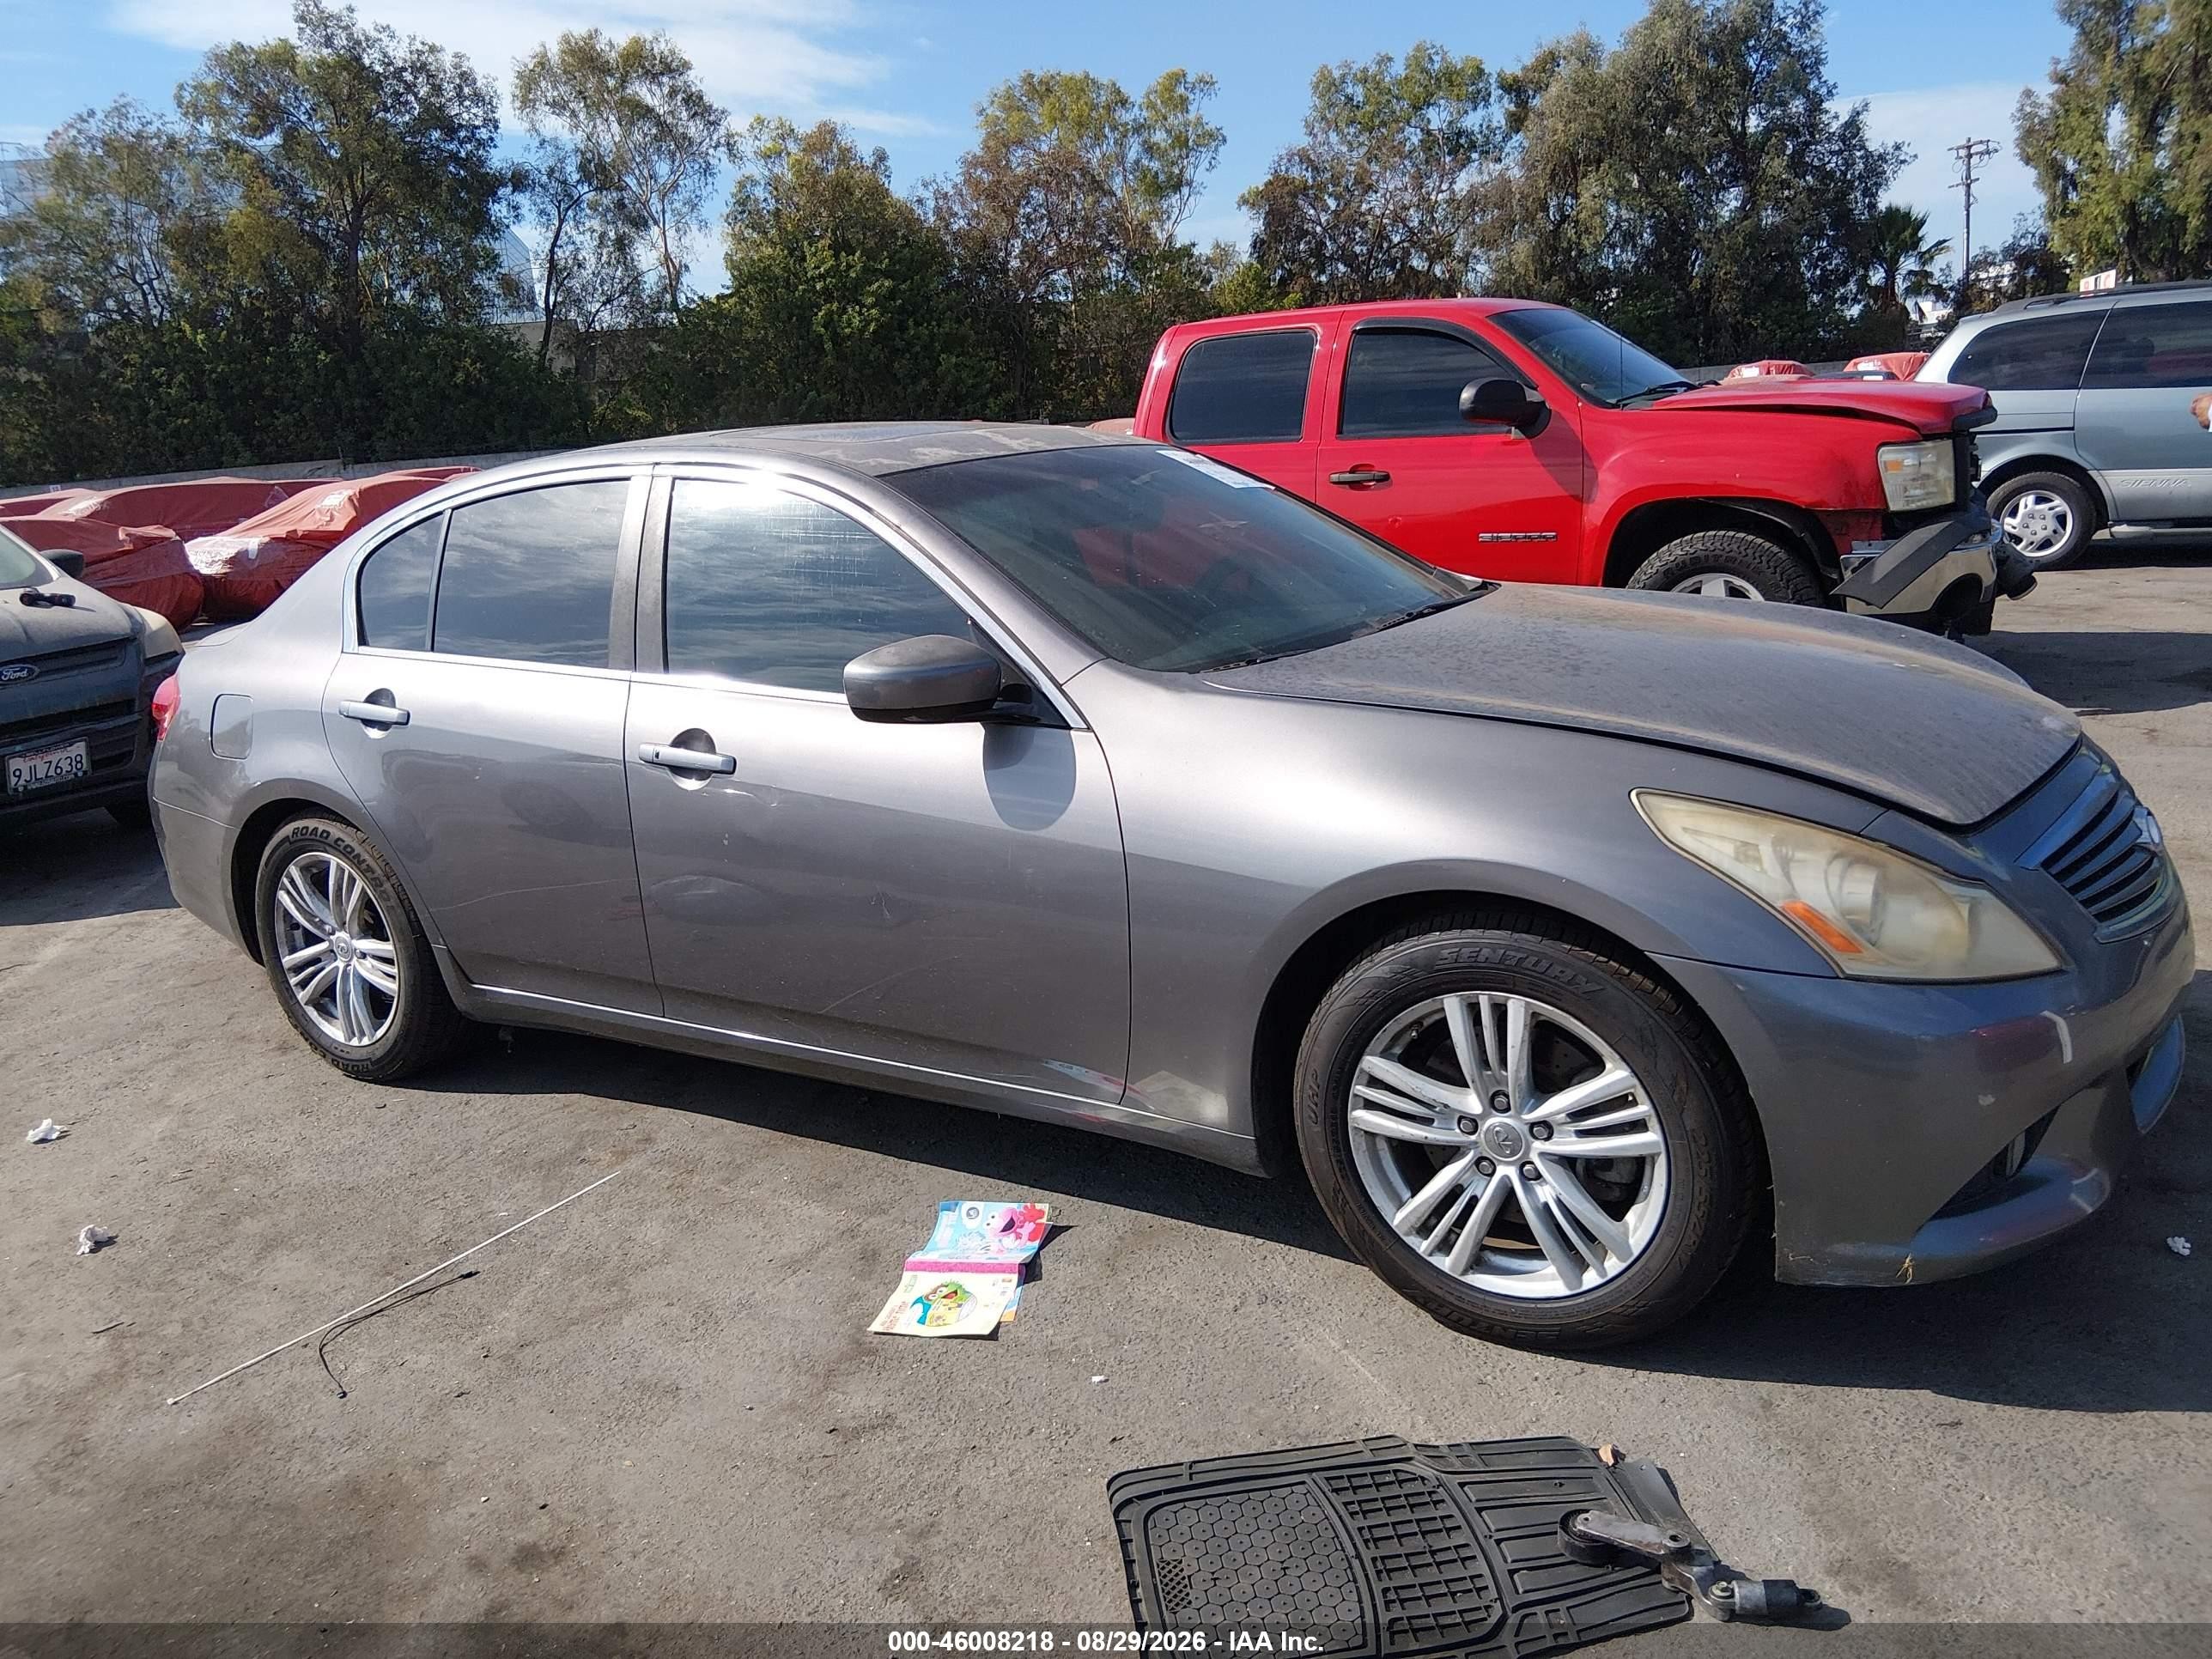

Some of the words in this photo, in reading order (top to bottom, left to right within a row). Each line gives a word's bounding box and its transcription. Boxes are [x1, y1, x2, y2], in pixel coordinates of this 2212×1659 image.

[2, 667, 28, 681] Ford
[12, 753, 84, 787] 9JLZ638
[291, 825, 331, 841] ROAD
[1435, 946, 1606, 996] SENTURY
